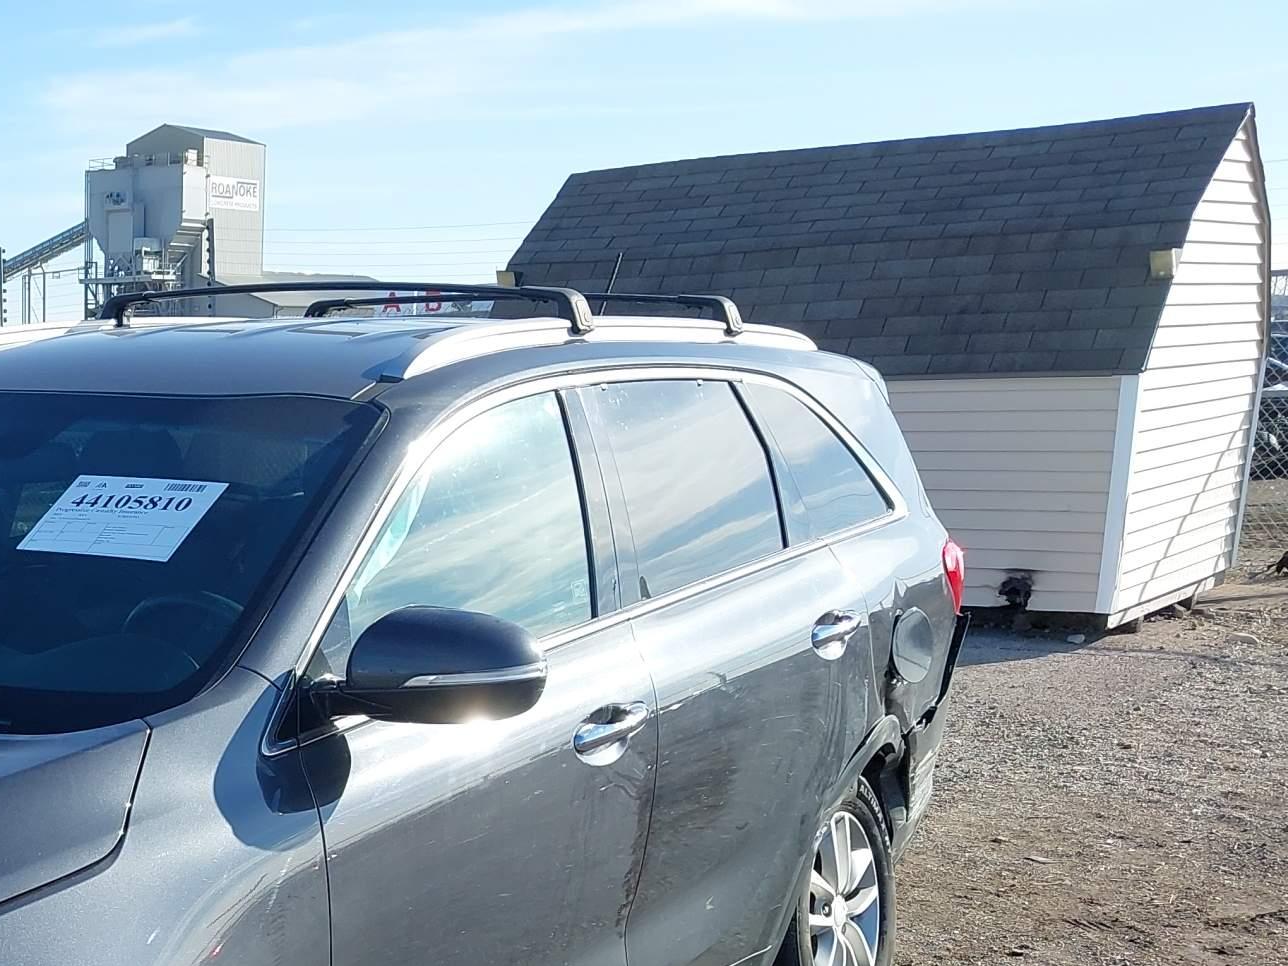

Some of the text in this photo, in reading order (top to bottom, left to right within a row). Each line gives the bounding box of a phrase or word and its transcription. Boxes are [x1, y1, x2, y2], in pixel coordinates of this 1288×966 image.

[211, 181, 257, 199] ROANOKE
[382, 292, 400, 312] A
[71, 493, 193, 512] 44105810
